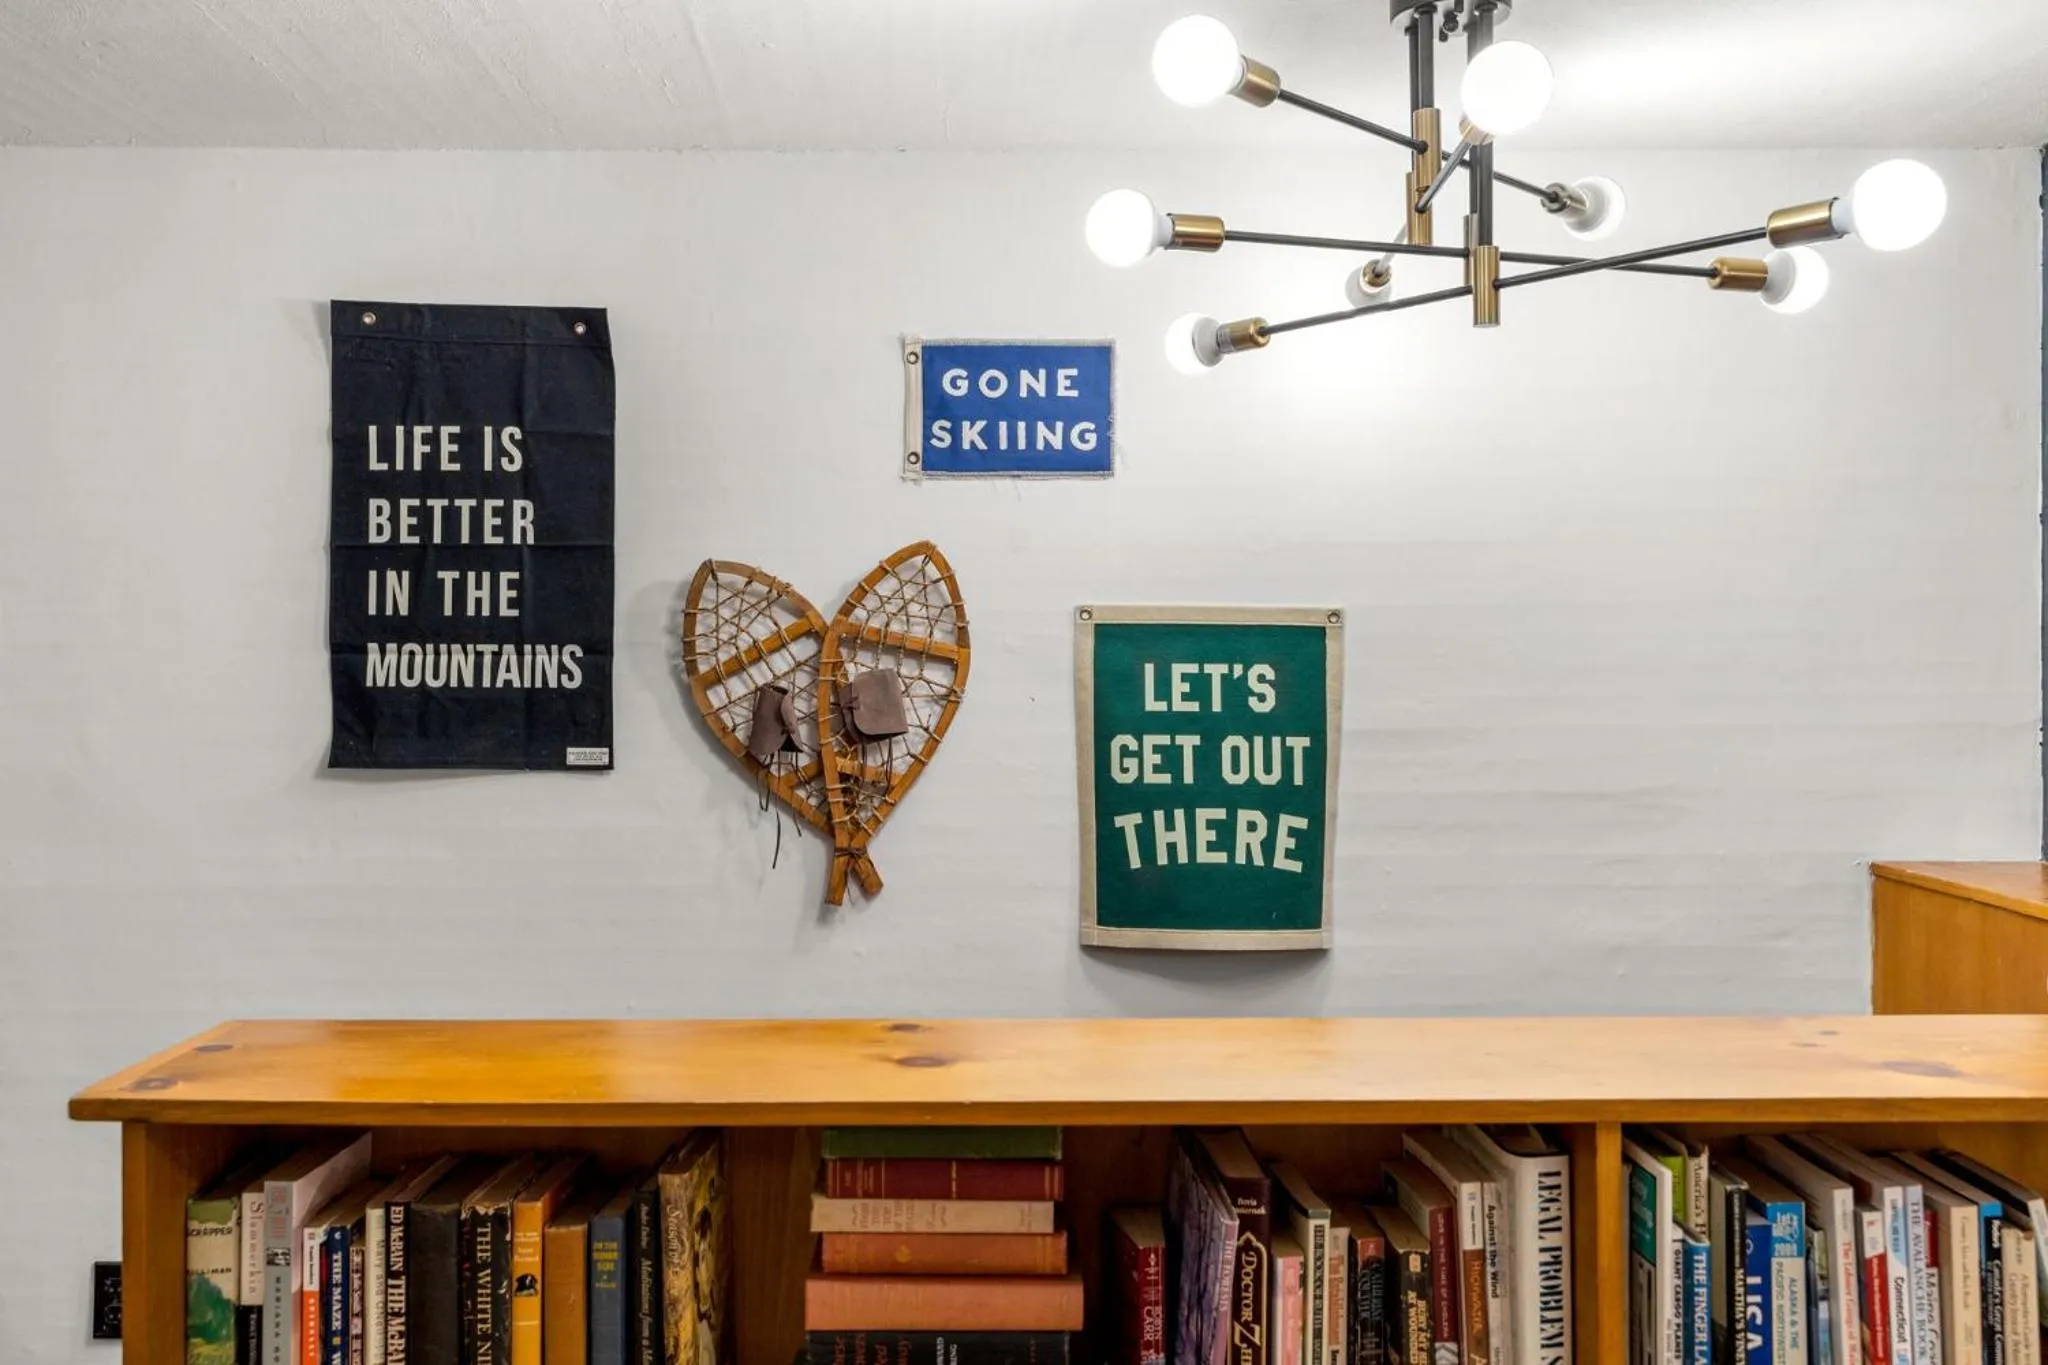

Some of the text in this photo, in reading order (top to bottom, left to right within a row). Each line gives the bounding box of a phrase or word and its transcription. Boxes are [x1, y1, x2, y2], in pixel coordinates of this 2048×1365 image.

[942, 367, 1080, 399] GONE
[368, 425, 523, 473] LIFE IS
[930, 419, 1099, 452] SKIING
[368, 498, 536, 546] BETTER
[368, 570, 520, 618] IN THE
[365, 642, 584, 690] MOUNTAINS
[1144, 663, 1277, 714] LET'S
[1110, 734, 1311, 787] GET OUT
[1114, 807, 1310, 874] THERE
[391, 1205, 404, 1223] ED
[1538, 1170, 1563, 1240] LEGAL
[1694, 1163, 1706, 1218] America's
[1910, 1201, 1921, 1227] THE
[249, 1201, 265, 1294] Slammerkin
[332, 1250, 342, 1284] THE
[391, 1224, 404, 1271] McBAIN
[477, 1222, 492, 1264] THE
[1438, 1247, 1446, 1263] THE
[1486, 1204, 1500, 1299] Against the Wind
[1241, 1251, 1257, 1322] DOCTOR
[1439, 1266, 1447, 1284] TIME
[1694, 1252, 1707, 1284] THE
[1775, 1261, 1784, 1301] PACIFIC
[1912, 1231, 1927, 1316] AVALANCHE
[332, 1286, 342, 1331] MAZE
[388, 1276, 406, 1313] THE
[477, 1267, 492, 1335] WHITE
[1440, 1287, 1448, 1299] OF
[1540, 1246, 1564, 1350] PROBLEM
[1673, 1248, 1682, 1360] GIANT CARGO PLANES
[1694, 1287, 1707, 1343] FINGER
[1733, 1268, 1746, 1330] MARTHA'S
[1789, 1277, 1798, 1316] ALASKA
[1894, 1276, 1907, 1344] Connecticut
[1143, 1305, 1154, 1342] CARR
[1440, 1301, 1449, 1338] CHOLERA
[1791, 1331, 1799, 1350] THE
